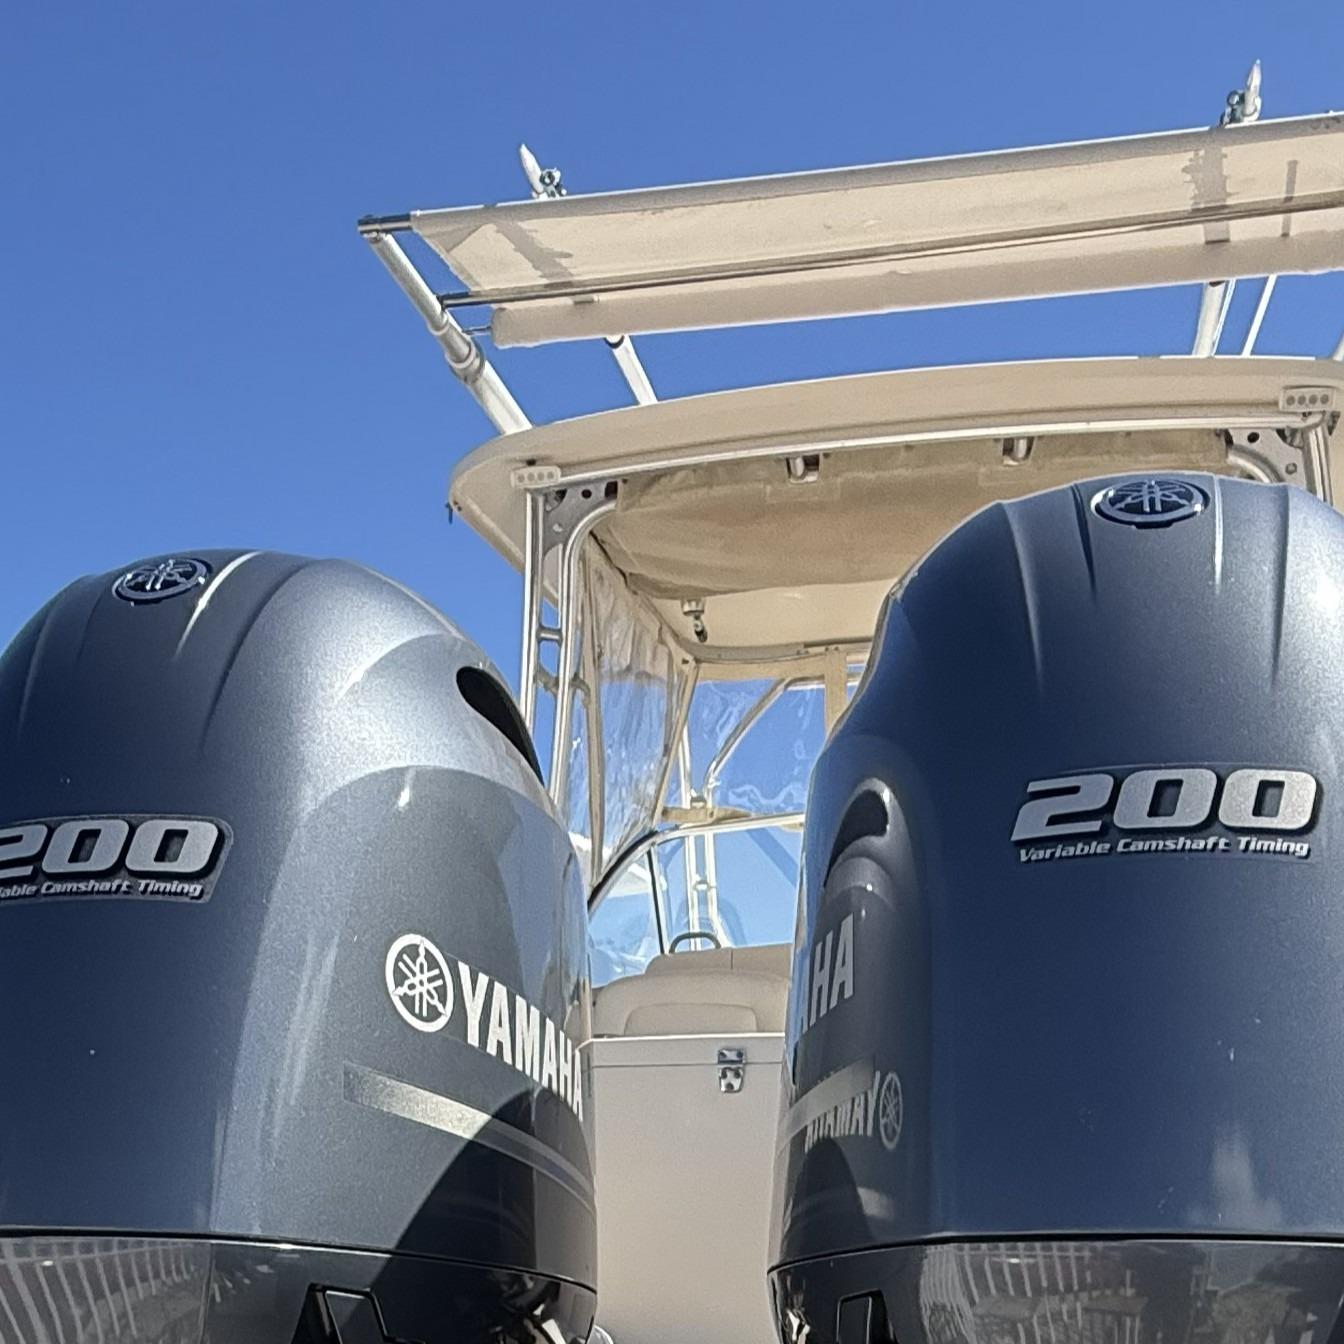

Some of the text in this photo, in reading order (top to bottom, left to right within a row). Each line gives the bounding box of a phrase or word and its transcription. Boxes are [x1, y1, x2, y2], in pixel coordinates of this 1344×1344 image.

[1011, 768, 1319, 842] 200
[1019, 836, 1309, 864] Variable Camshaft Timing
[41, 878, 129, 896] Camshaft
[138, 878, 203, 898] Timing
[457, 960, 585, 1123] YAMAHA
